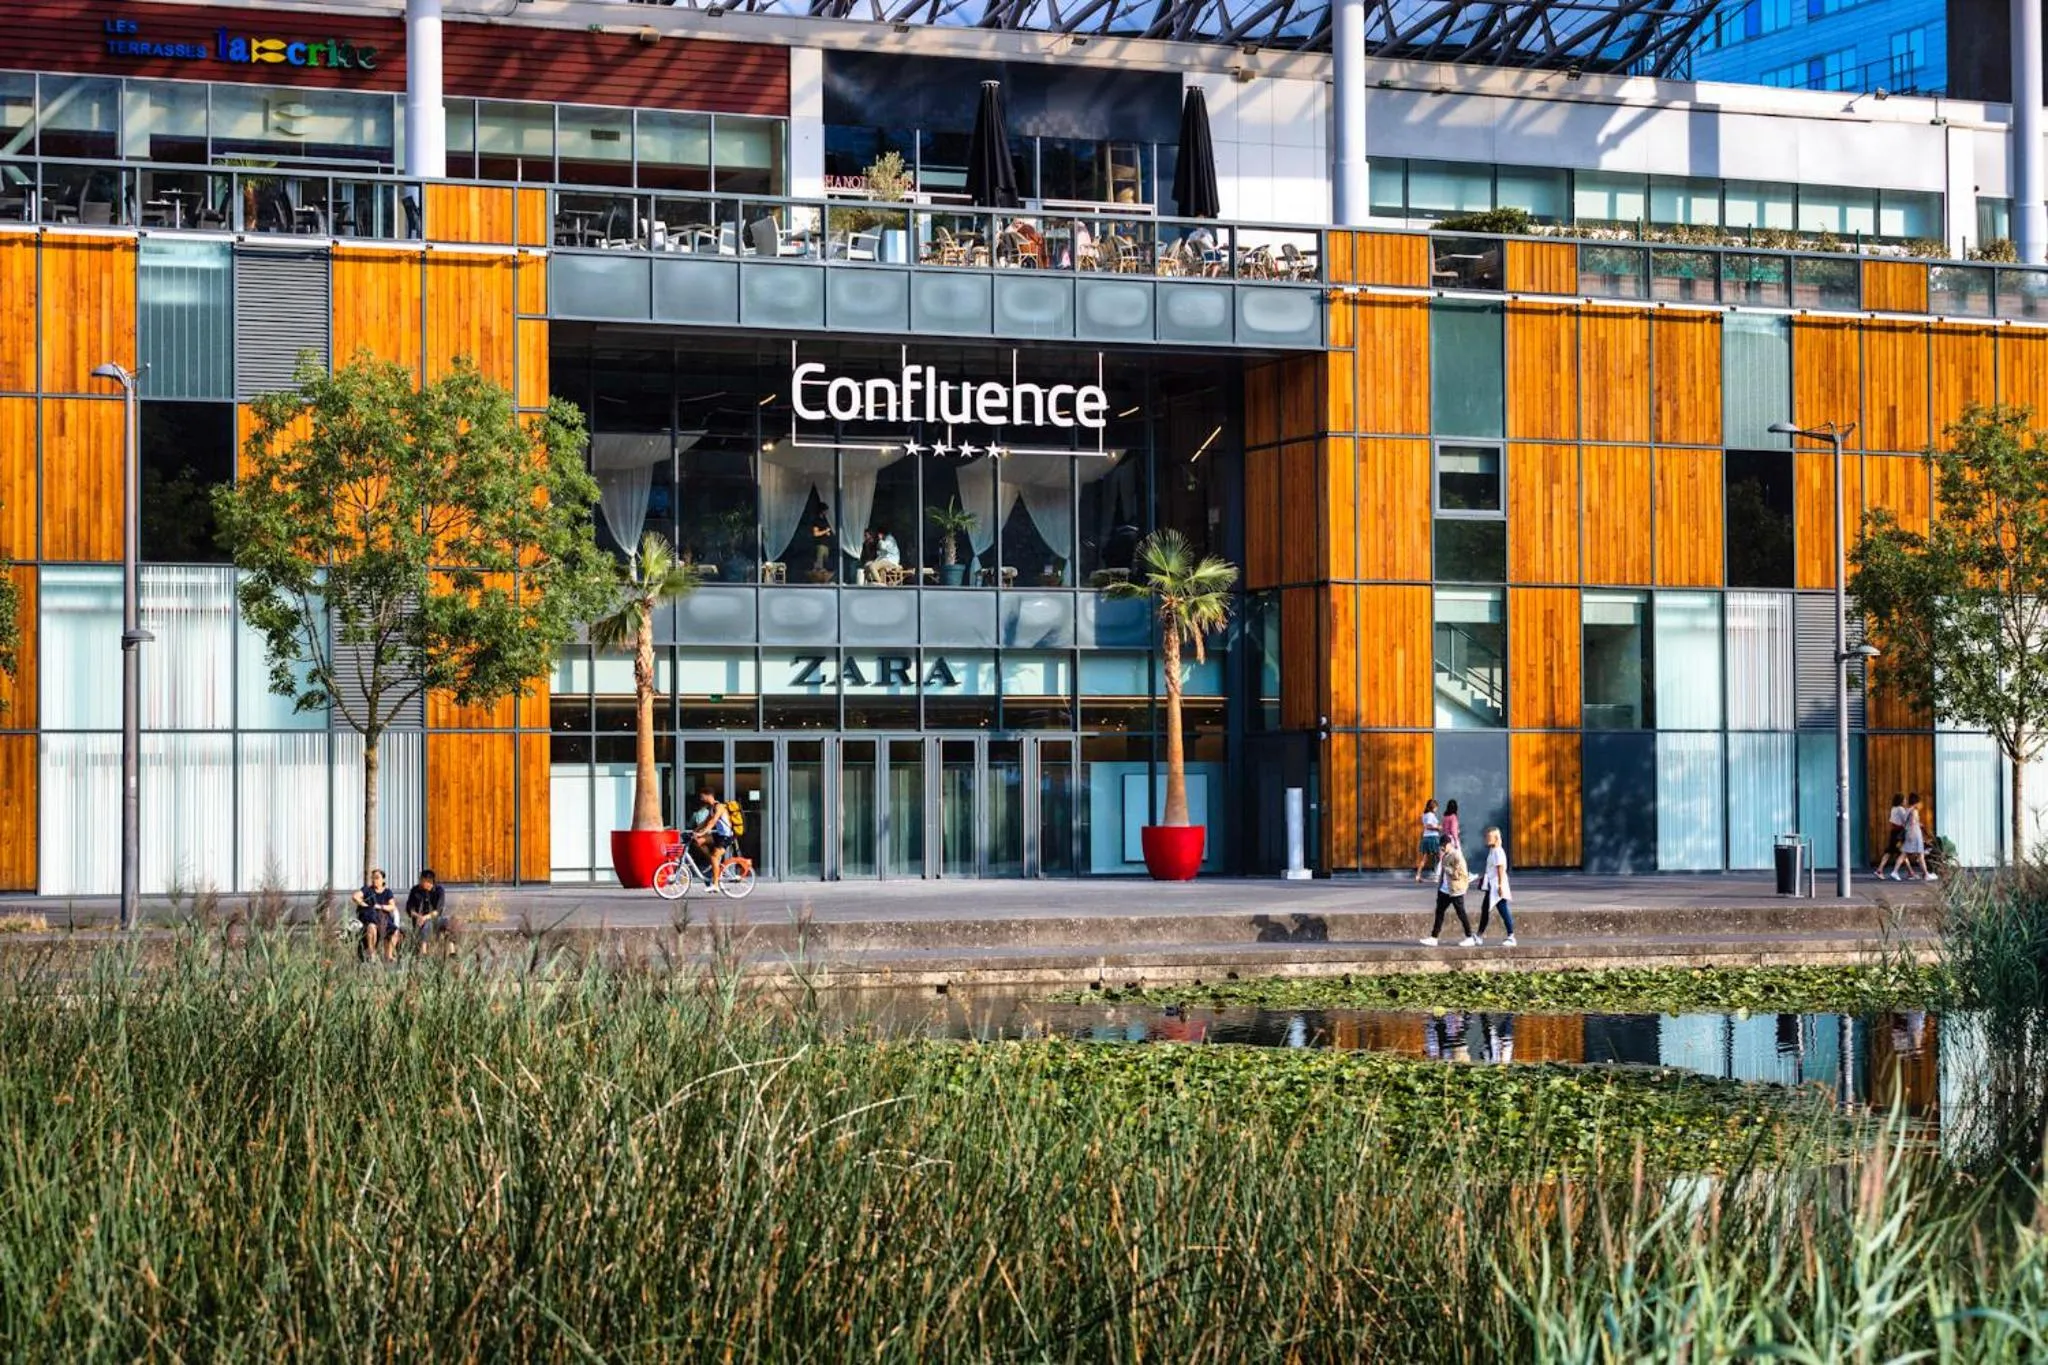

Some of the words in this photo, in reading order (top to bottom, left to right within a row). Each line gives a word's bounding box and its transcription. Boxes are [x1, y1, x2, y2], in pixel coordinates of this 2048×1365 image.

[105, 19, 138, 34] LES
[106, 40, 208, 58] TERRASSES
[213, 26, 249, 63] la
[792, 363, 1107, 427] Confluence
[788, 656, 961, 687] ZARA
